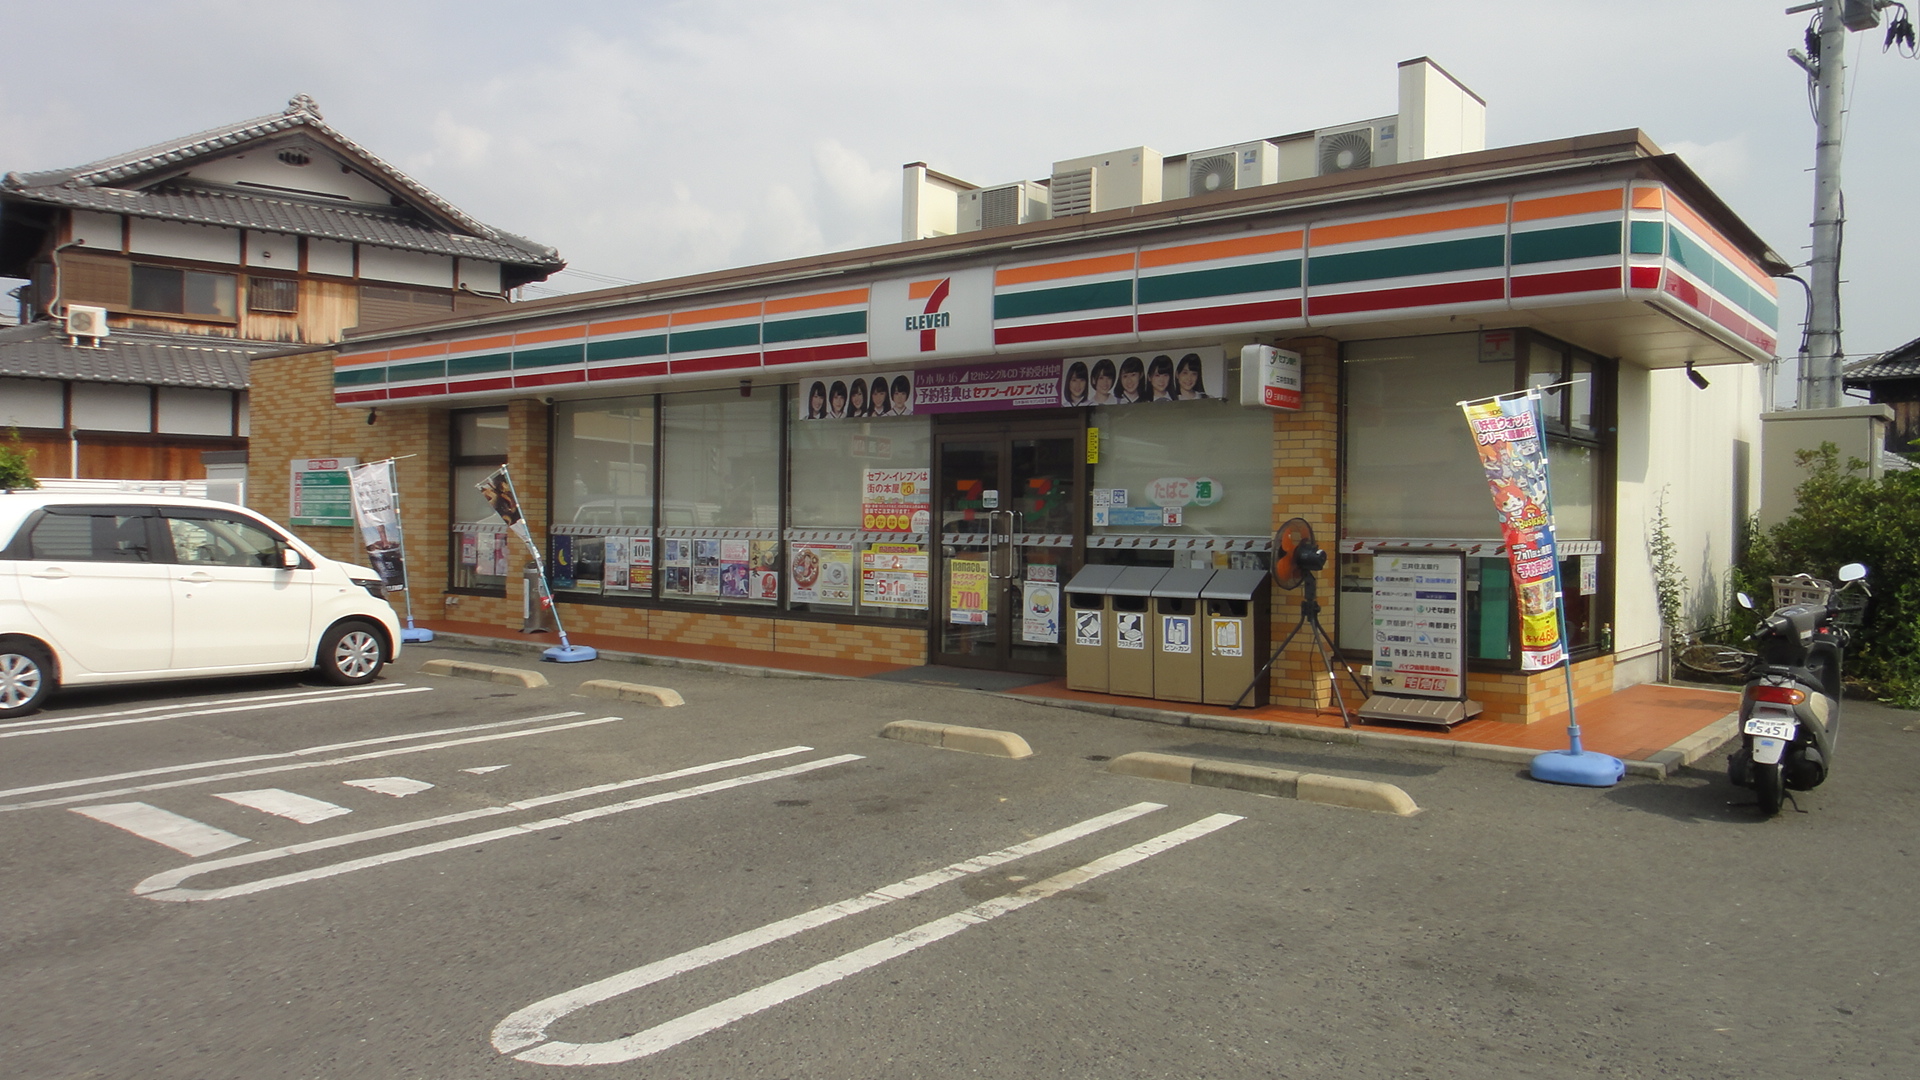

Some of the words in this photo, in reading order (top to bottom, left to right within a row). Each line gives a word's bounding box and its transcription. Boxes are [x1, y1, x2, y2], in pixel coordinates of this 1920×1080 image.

[1154, 481, 1189, 499] たばこ
[1195, 481, 1212, 499] 酒
[958, 591, 980, 609] 700
[1756, 725, 1789, 737] 5451
